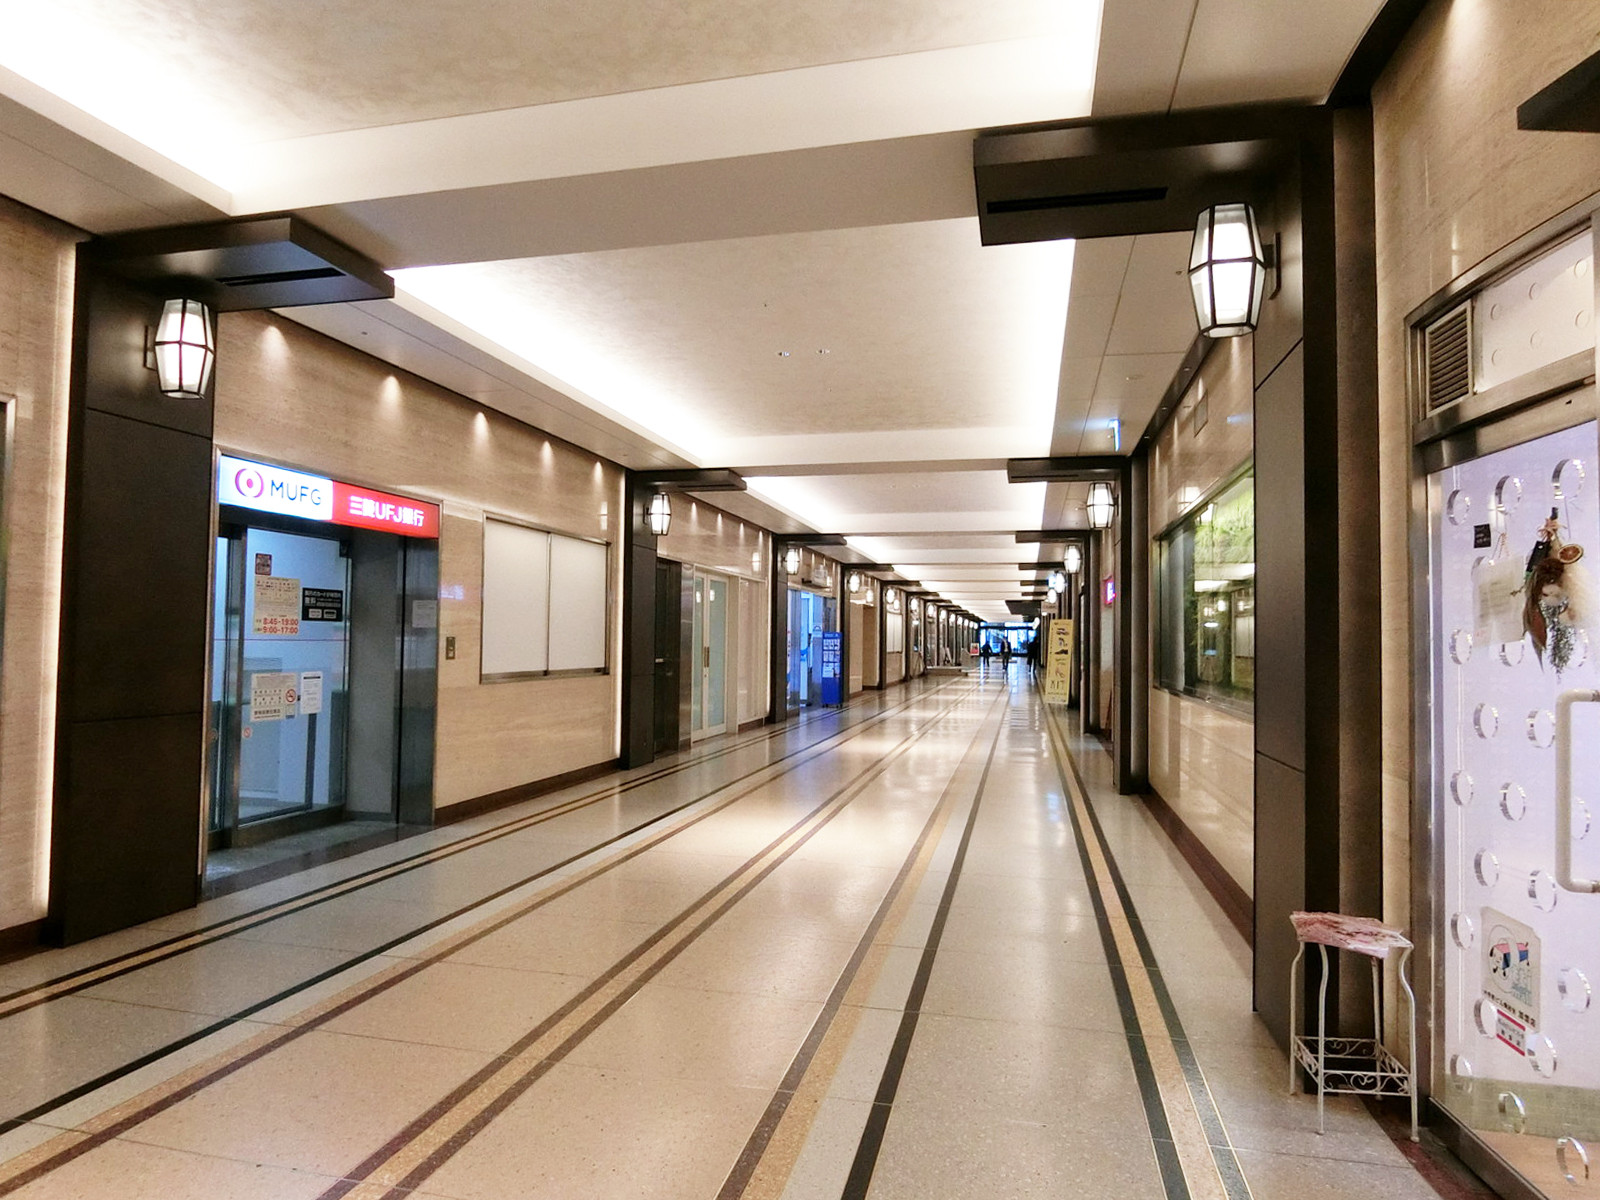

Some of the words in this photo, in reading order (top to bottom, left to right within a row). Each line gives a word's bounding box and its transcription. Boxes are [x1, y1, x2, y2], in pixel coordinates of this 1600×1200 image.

[271, 480, 321, 505] MUFG
[350, 497, 424, 526] 三菱UFJ銀行
